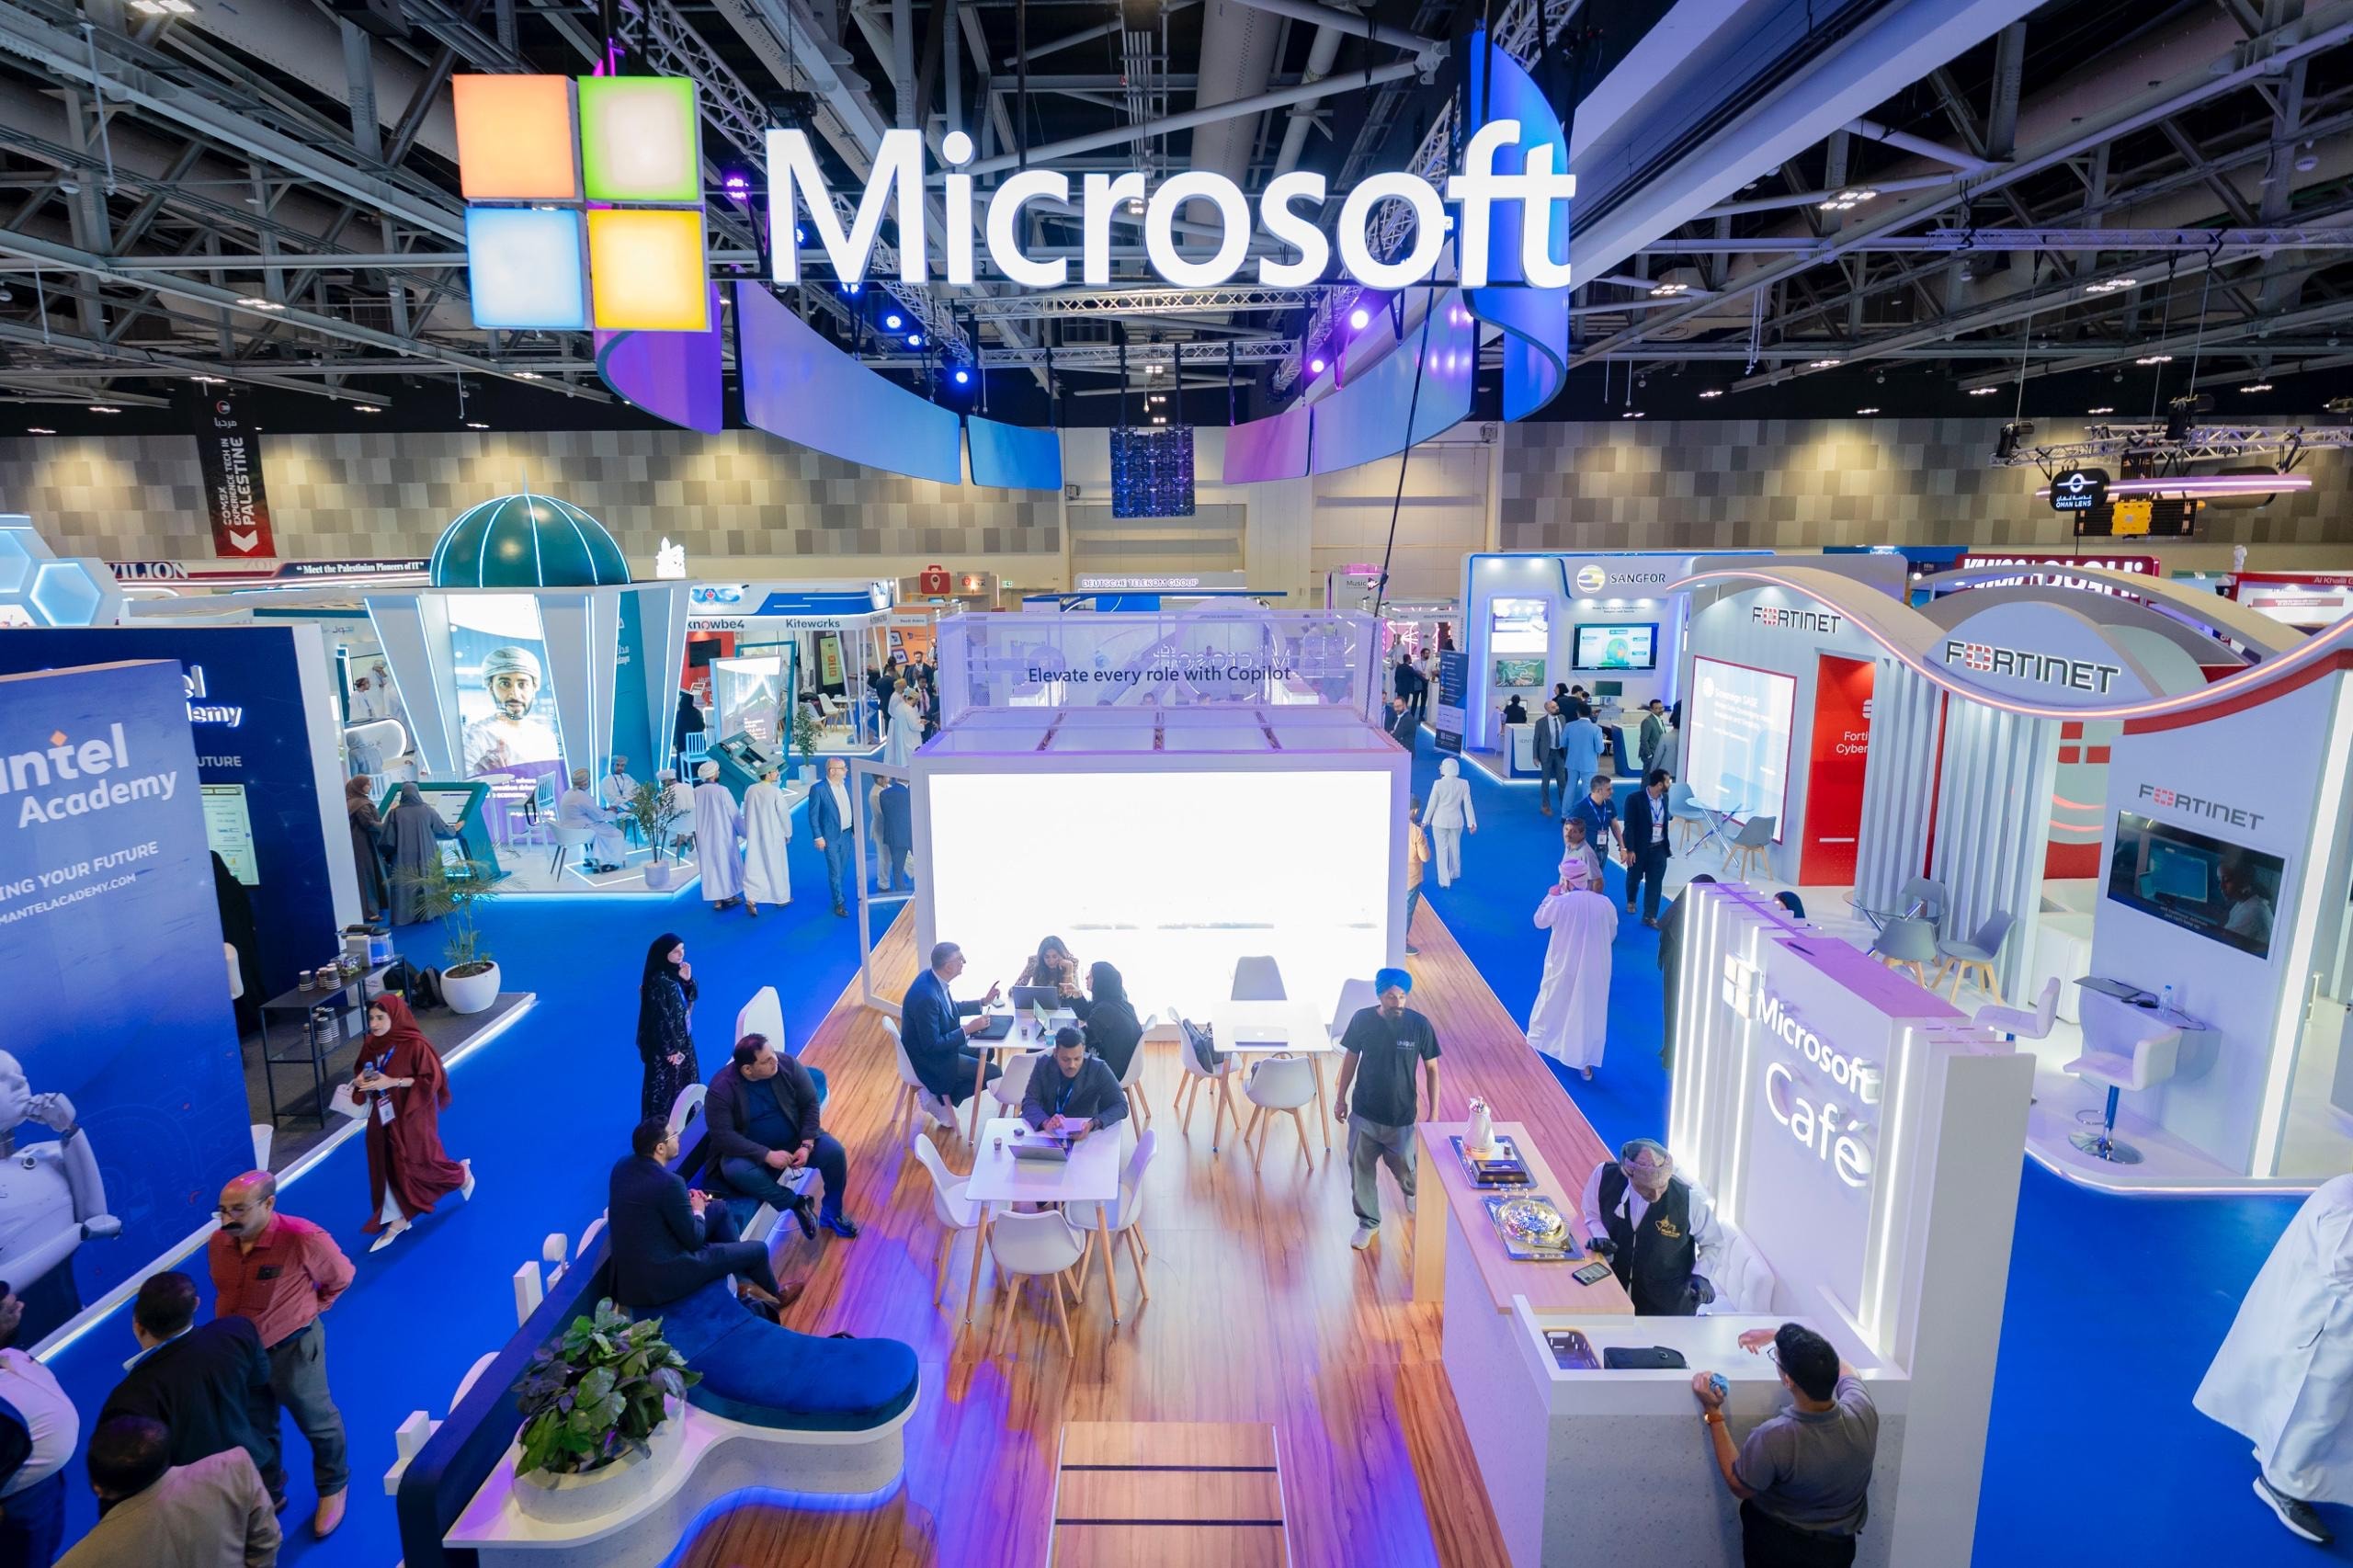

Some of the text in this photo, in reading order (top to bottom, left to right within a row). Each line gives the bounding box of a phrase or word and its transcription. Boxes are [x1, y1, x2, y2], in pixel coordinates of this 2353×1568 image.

[767, 119, 1576, 290] Microsoft
[221, 438, 242, 525] EXPERIENCE TECH IN
[230, 437, 256, 525] PALESTINE
[303, 565, 323, 574] Meet
[324, 564, 336, 573] the
[337, 563, 375, 573] Palestinian
[1082, 578, 1199, 587] DEUTSCHE TELEKOM GROUP
[1610, 574, 1666, 584] SANGFOR
[786, 619, 840, 628] Kiteworks
[1753, 607, 1841, 633] FORTINET
[1029, 665, 1291, 686] Elevate every role with Copilot
[1946, 641, 2120, 694] FORTINET
[18, 770, 177, 828] Academy
[2139, 783, 2265, 831] FORTINET
[38, 862, 90, 888] YOUR
[93, 841, 159, 872] FUTURE
[1756, 987, 1880, 1104] Microsoft
[1765, 1062, 1872, 1187] Café
